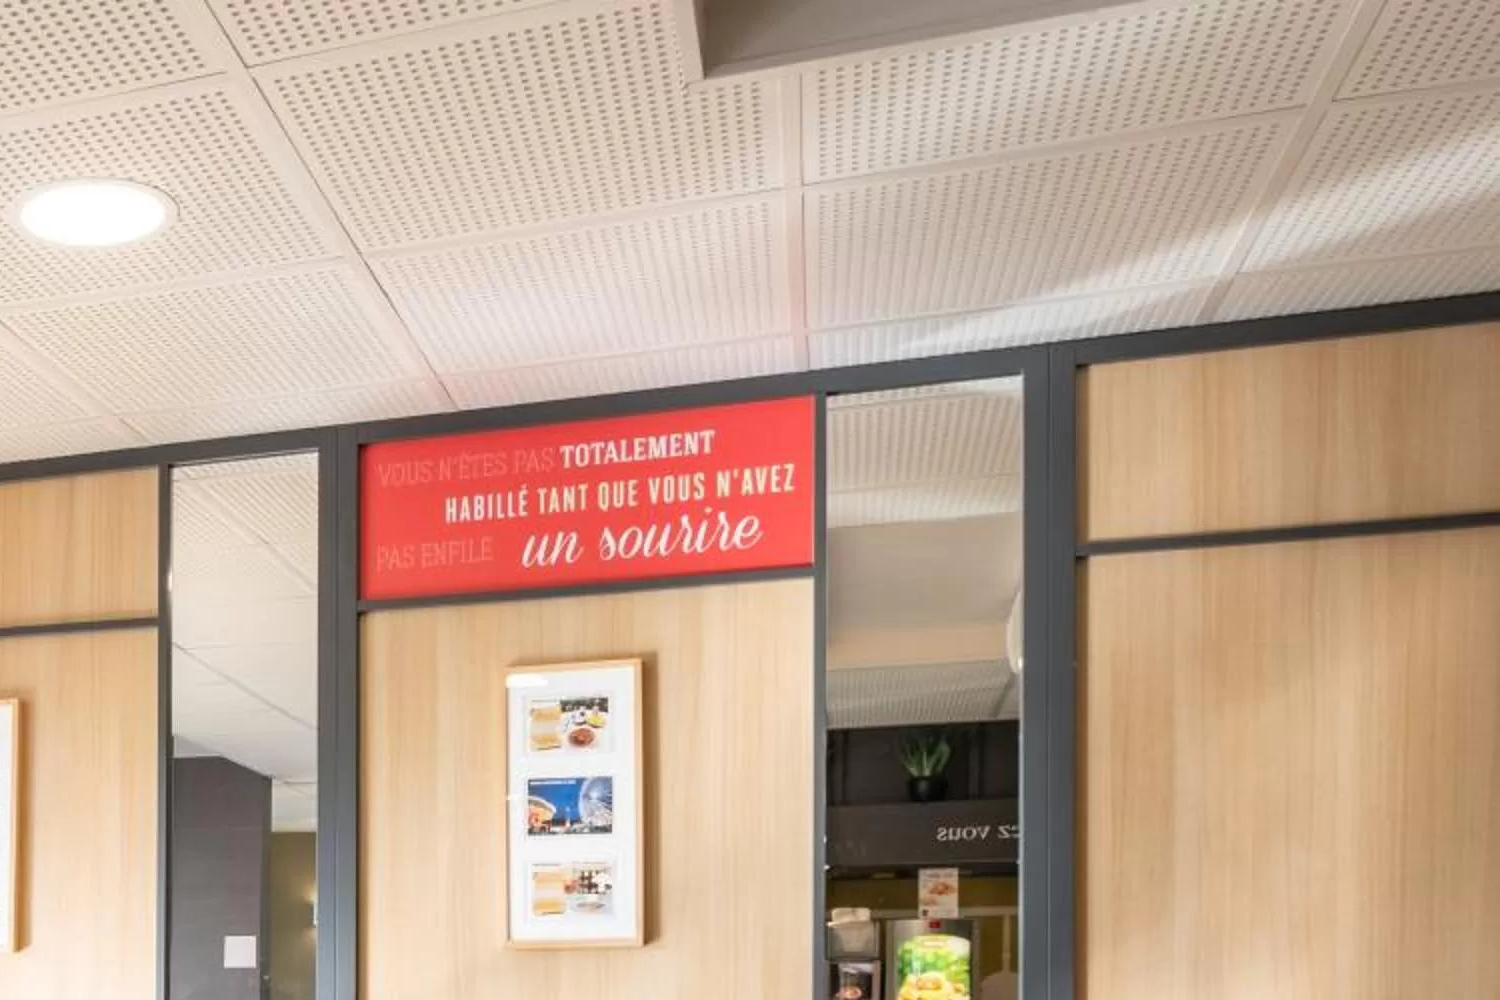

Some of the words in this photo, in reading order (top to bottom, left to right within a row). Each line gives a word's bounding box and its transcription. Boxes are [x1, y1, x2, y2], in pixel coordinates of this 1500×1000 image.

[377, 460, 433, 488] VOUS
[513, 447, 555, 473] PAS
[560, 430, 716, 468] TOTALEMENT
[445, 484, 529, 523] HABILLÉ
[538, 484, 588, 514] TANT
[598, 480, 638, 511] QUE
[648, 472, 706, 505] VOUS
[716, 463, 795, 497] N'AVEZ
[376, 543, 416, 575] PAS
[521, 530, 584, 568] un
[599, 507, 764, 561] sourire
